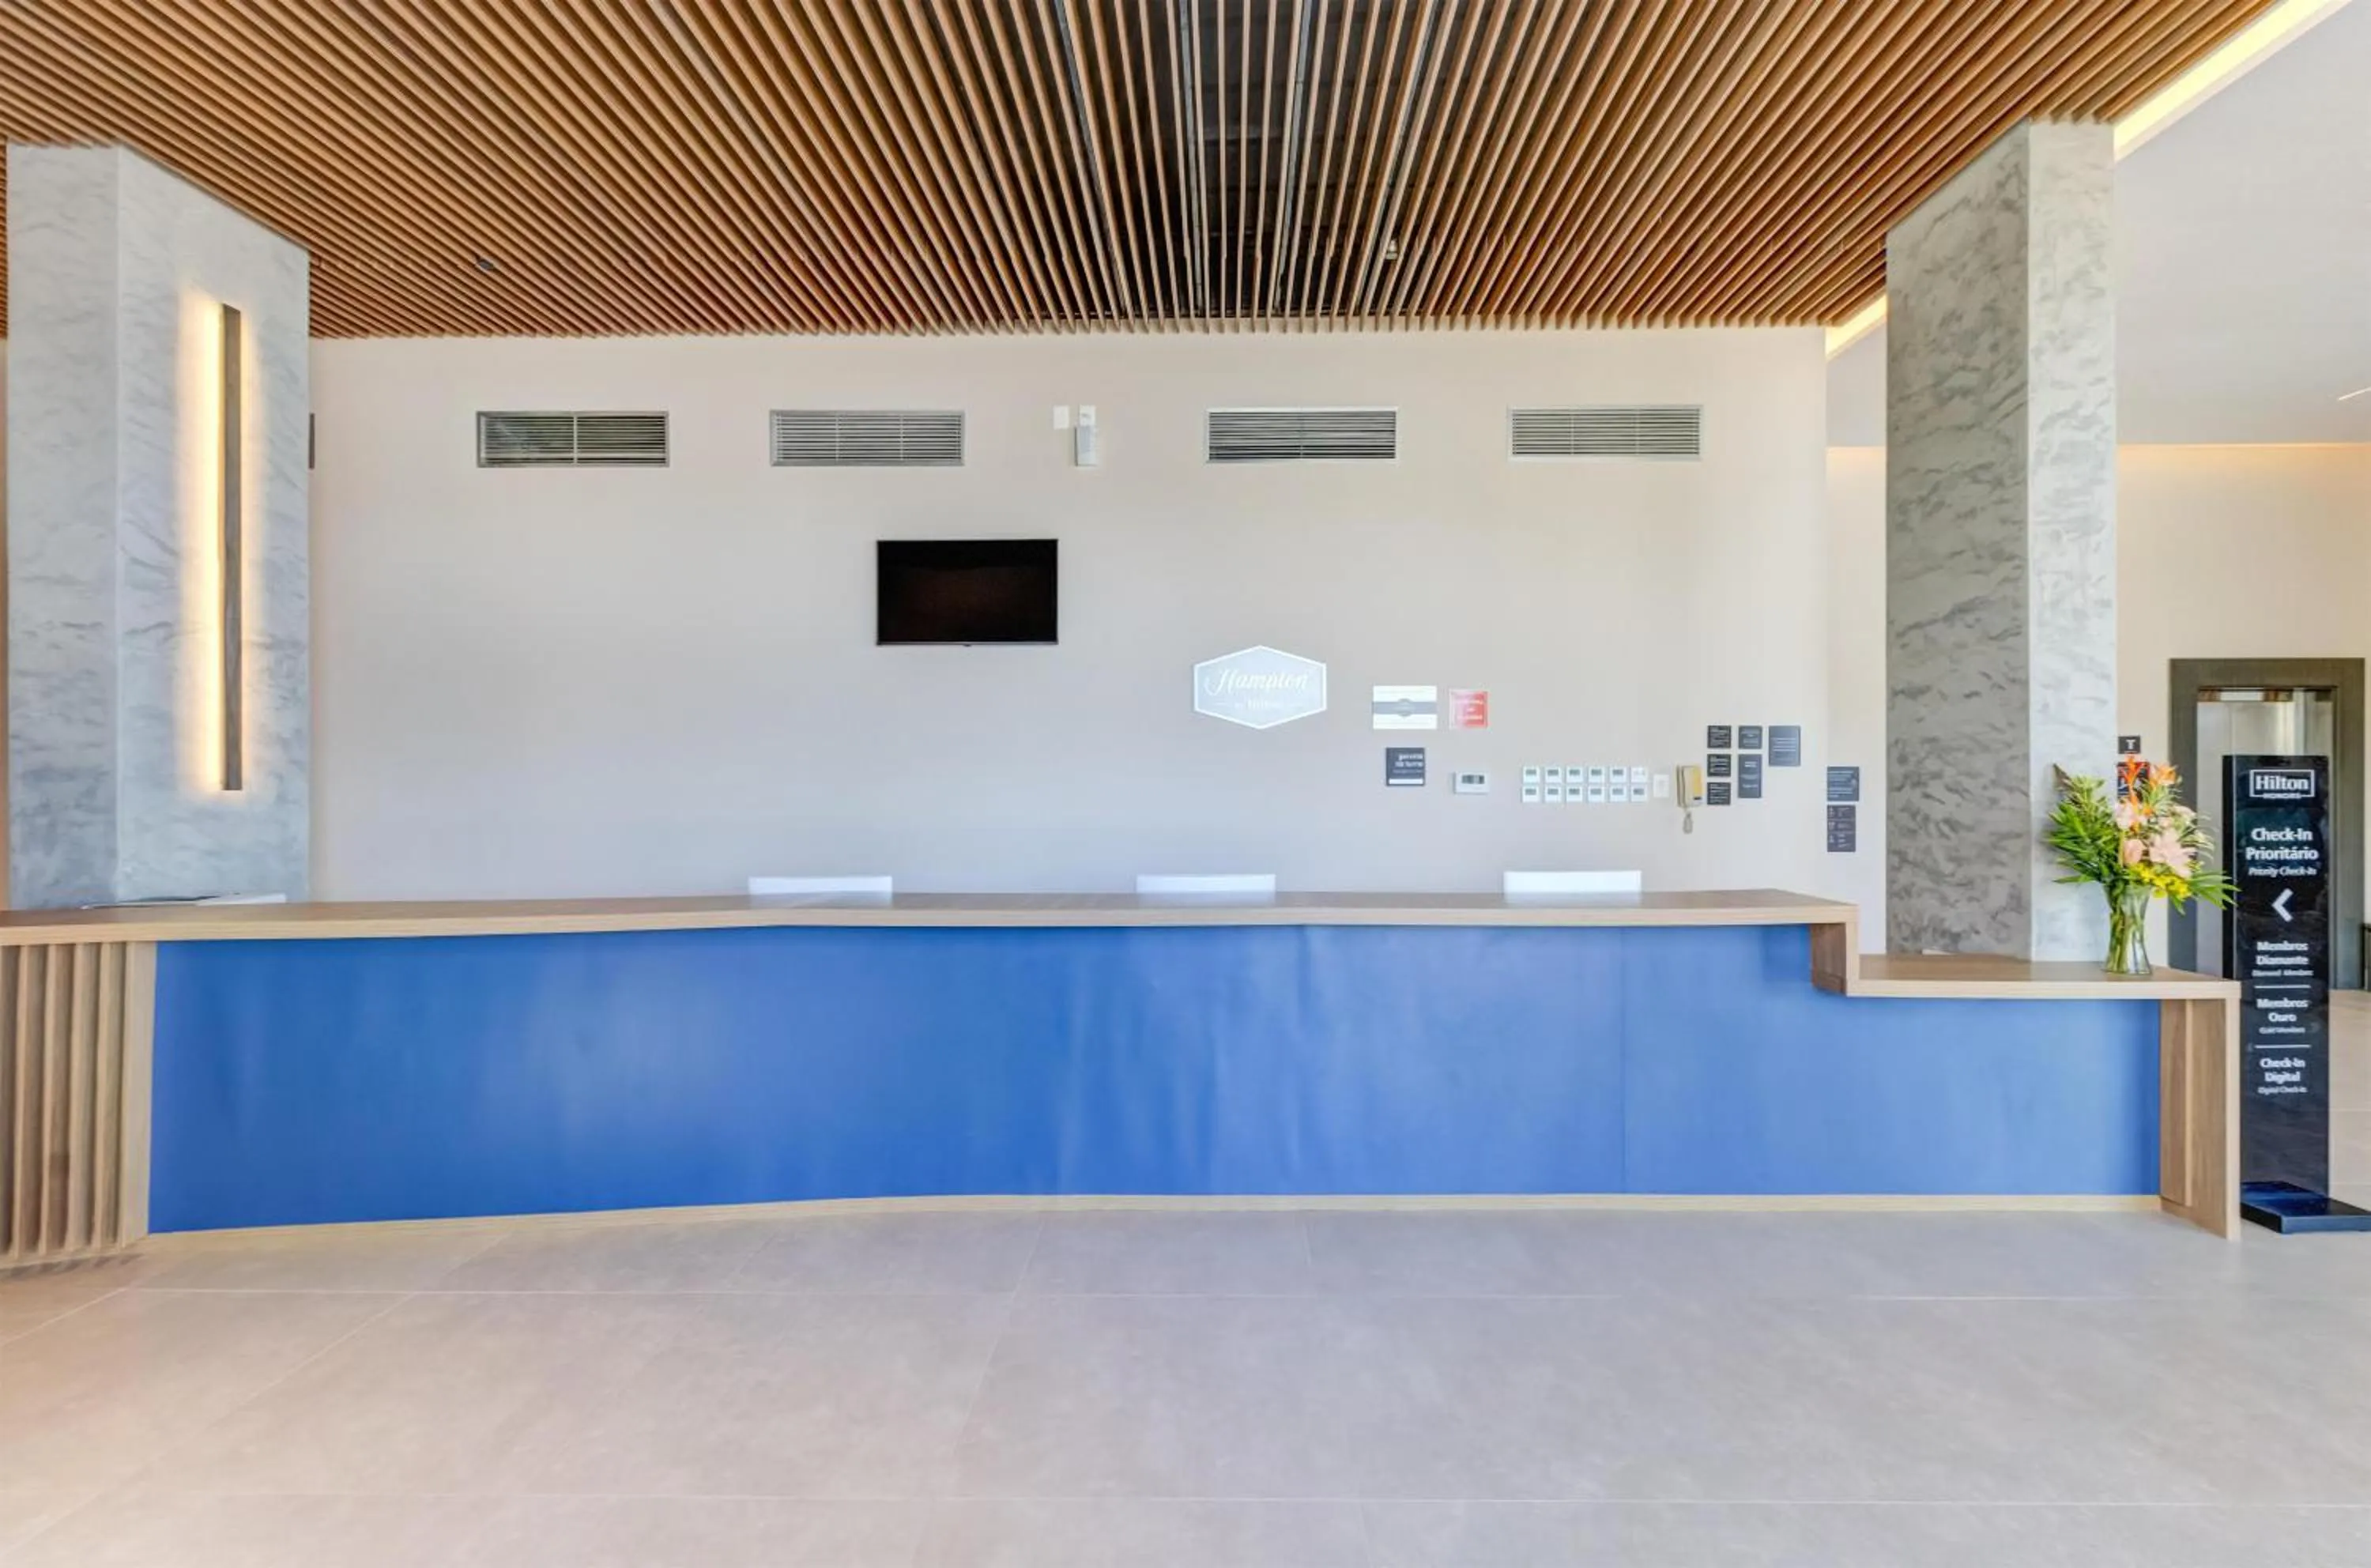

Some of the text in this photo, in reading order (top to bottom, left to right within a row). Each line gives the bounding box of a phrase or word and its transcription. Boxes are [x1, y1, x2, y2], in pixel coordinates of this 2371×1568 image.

[1204, 669, 1309, 695] Hampton
[2256, 775, 2309, 790] Hilton
[2245, 846, 2319, 860] Prioritário
[2256, 940, 2308, 951] Membros
[2256, 955, 2309, 965] Diamante
[2256, 997, 2309, 1008] Membros
[2267, 1012, 2297, 1022] Ouro
[2264, 1071, 2301, 1084] Digital
